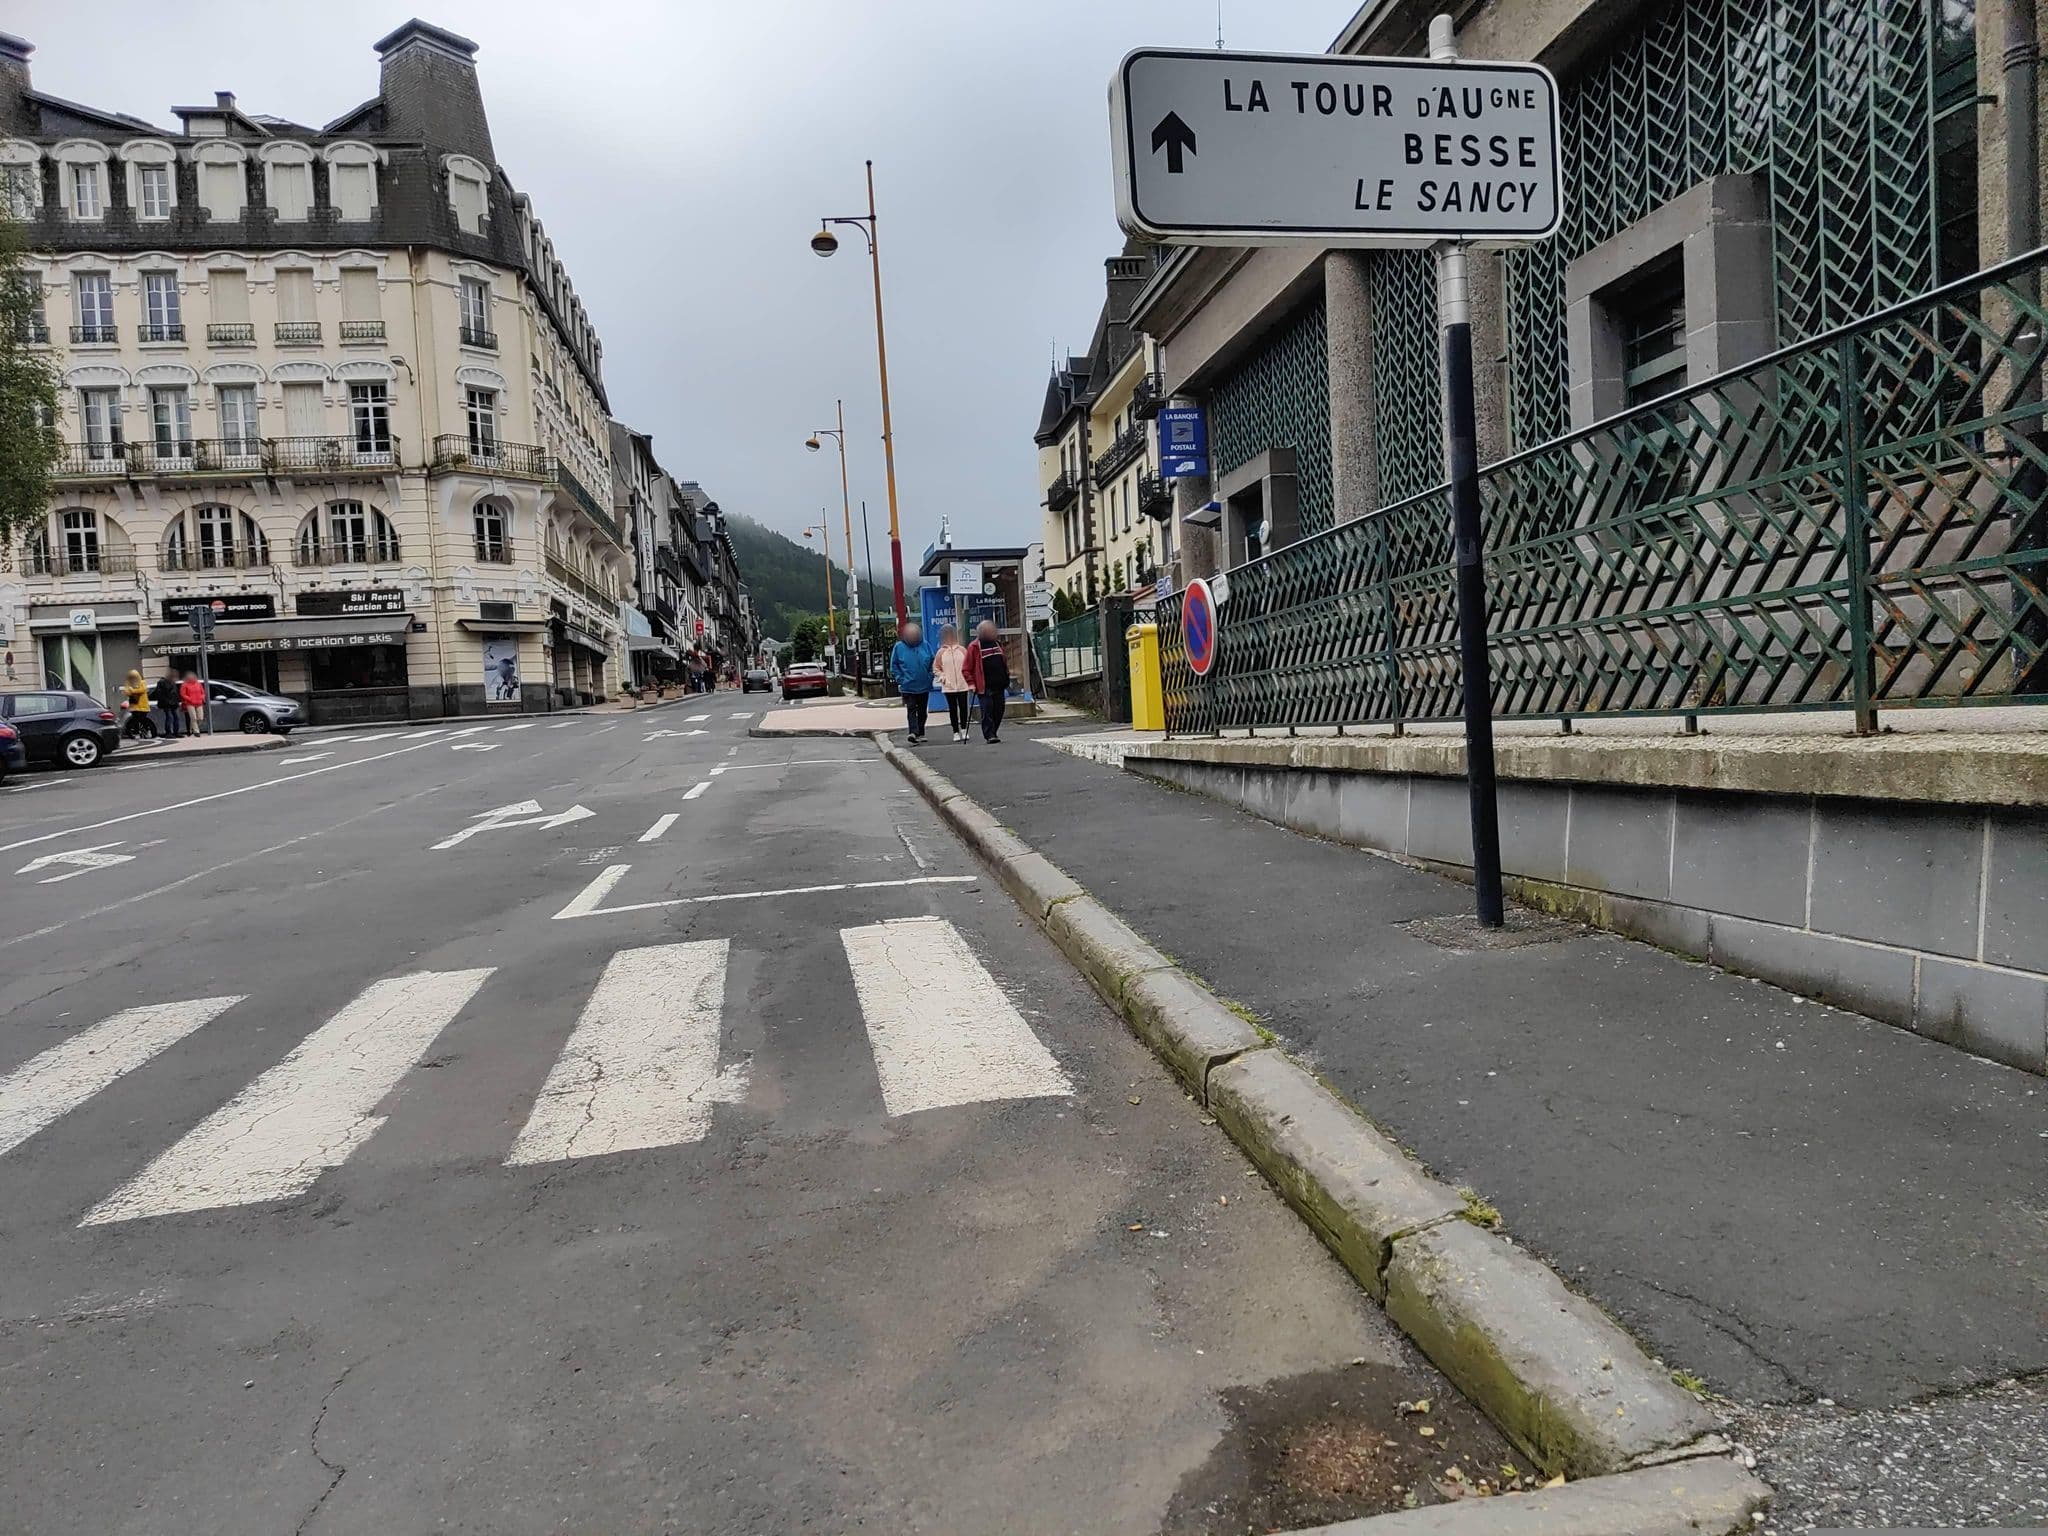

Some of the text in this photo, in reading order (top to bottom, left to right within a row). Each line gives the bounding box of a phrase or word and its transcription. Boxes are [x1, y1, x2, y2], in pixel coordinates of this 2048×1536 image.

[1223, 79, 1270, 112] LA
[1291, 81, 1393, 117] TOUR
[1404, 132, 1537, 168] BESSE
[1354, 178, 1538, 213] LE SANCY
[1170, 443, 1196, 451] POSTALE
[350, 592, 401, 602] Ski Rental
[342, 601, 402, 612] Location Ski
[220, 641, 235, 650] de
[240, 639, 273, 652] sport
[297, 633, 393, 648] location de skis
